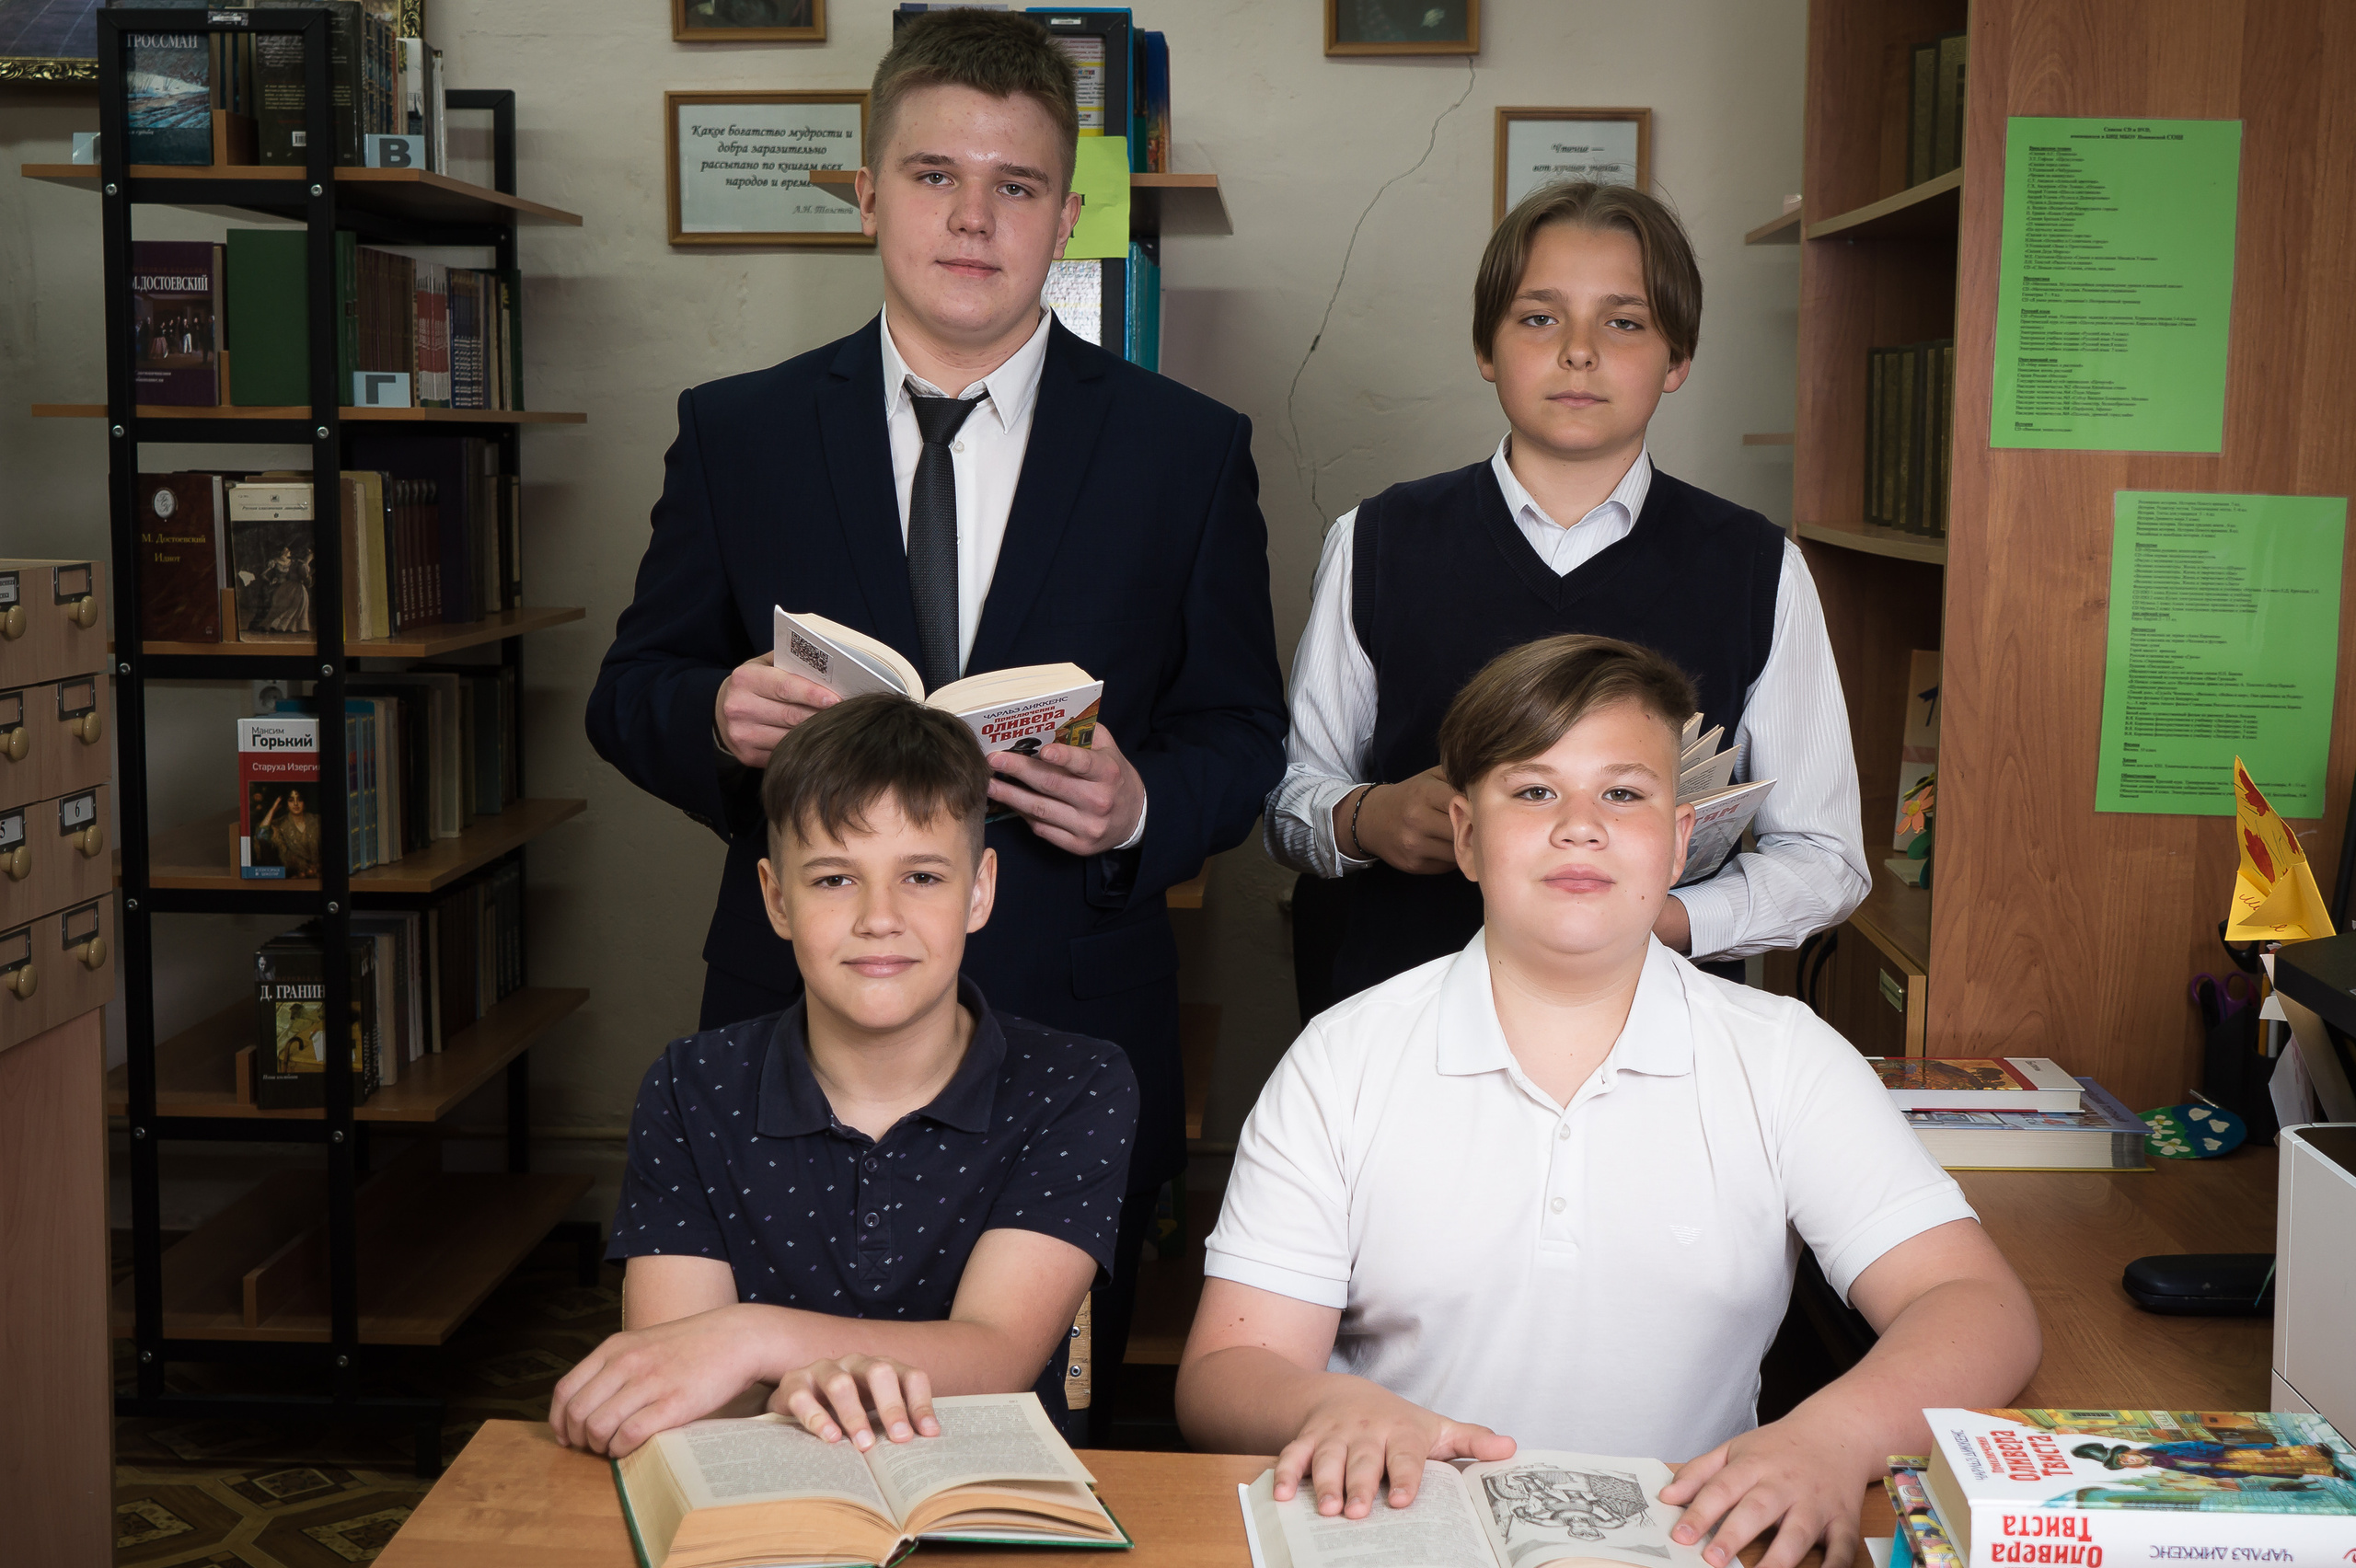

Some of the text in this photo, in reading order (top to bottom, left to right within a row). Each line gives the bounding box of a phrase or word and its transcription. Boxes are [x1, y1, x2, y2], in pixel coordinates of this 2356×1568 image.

[126, 33, 199, 49] ГРОССМАН
[691, 123, 853, 141] Какое богатство мудрости и
[379, 138, 411, 168] В
[717, 141, 827, 157] добра заразительно
[700, 160, 759, 172] рассыпано
[762, 162, 775, 170] по
[778, 161, 818, 173] книгам
[725, 173, 816, 190] народов и време
[365, 375, 397, 405] Г
[141, 533, 206, 545] М. Достоевский
[154, 552, 181, 562] Идиот
[983, 696, 1068, 720] ЧАРЛЬЗ ДИККЕНС
[251, 726, 284, 734] Максим
[251, 733, 313, 750] Горький
[251, 762, 286, 773] Старуха
[75, 800, 81, 818] 6
[260, 985, 272, 1001] Д.
[1950, 1429, 1988, 1481] ЧАРЛЬЗ ДИККЕНС
[2002, 1514, 2092, 1542] Твиста
[1991, 1540, 2103, 1568] Оливера
[2149, 1544, 2294, 1562] ЧАРЛЬЗ ДИККЕНС
